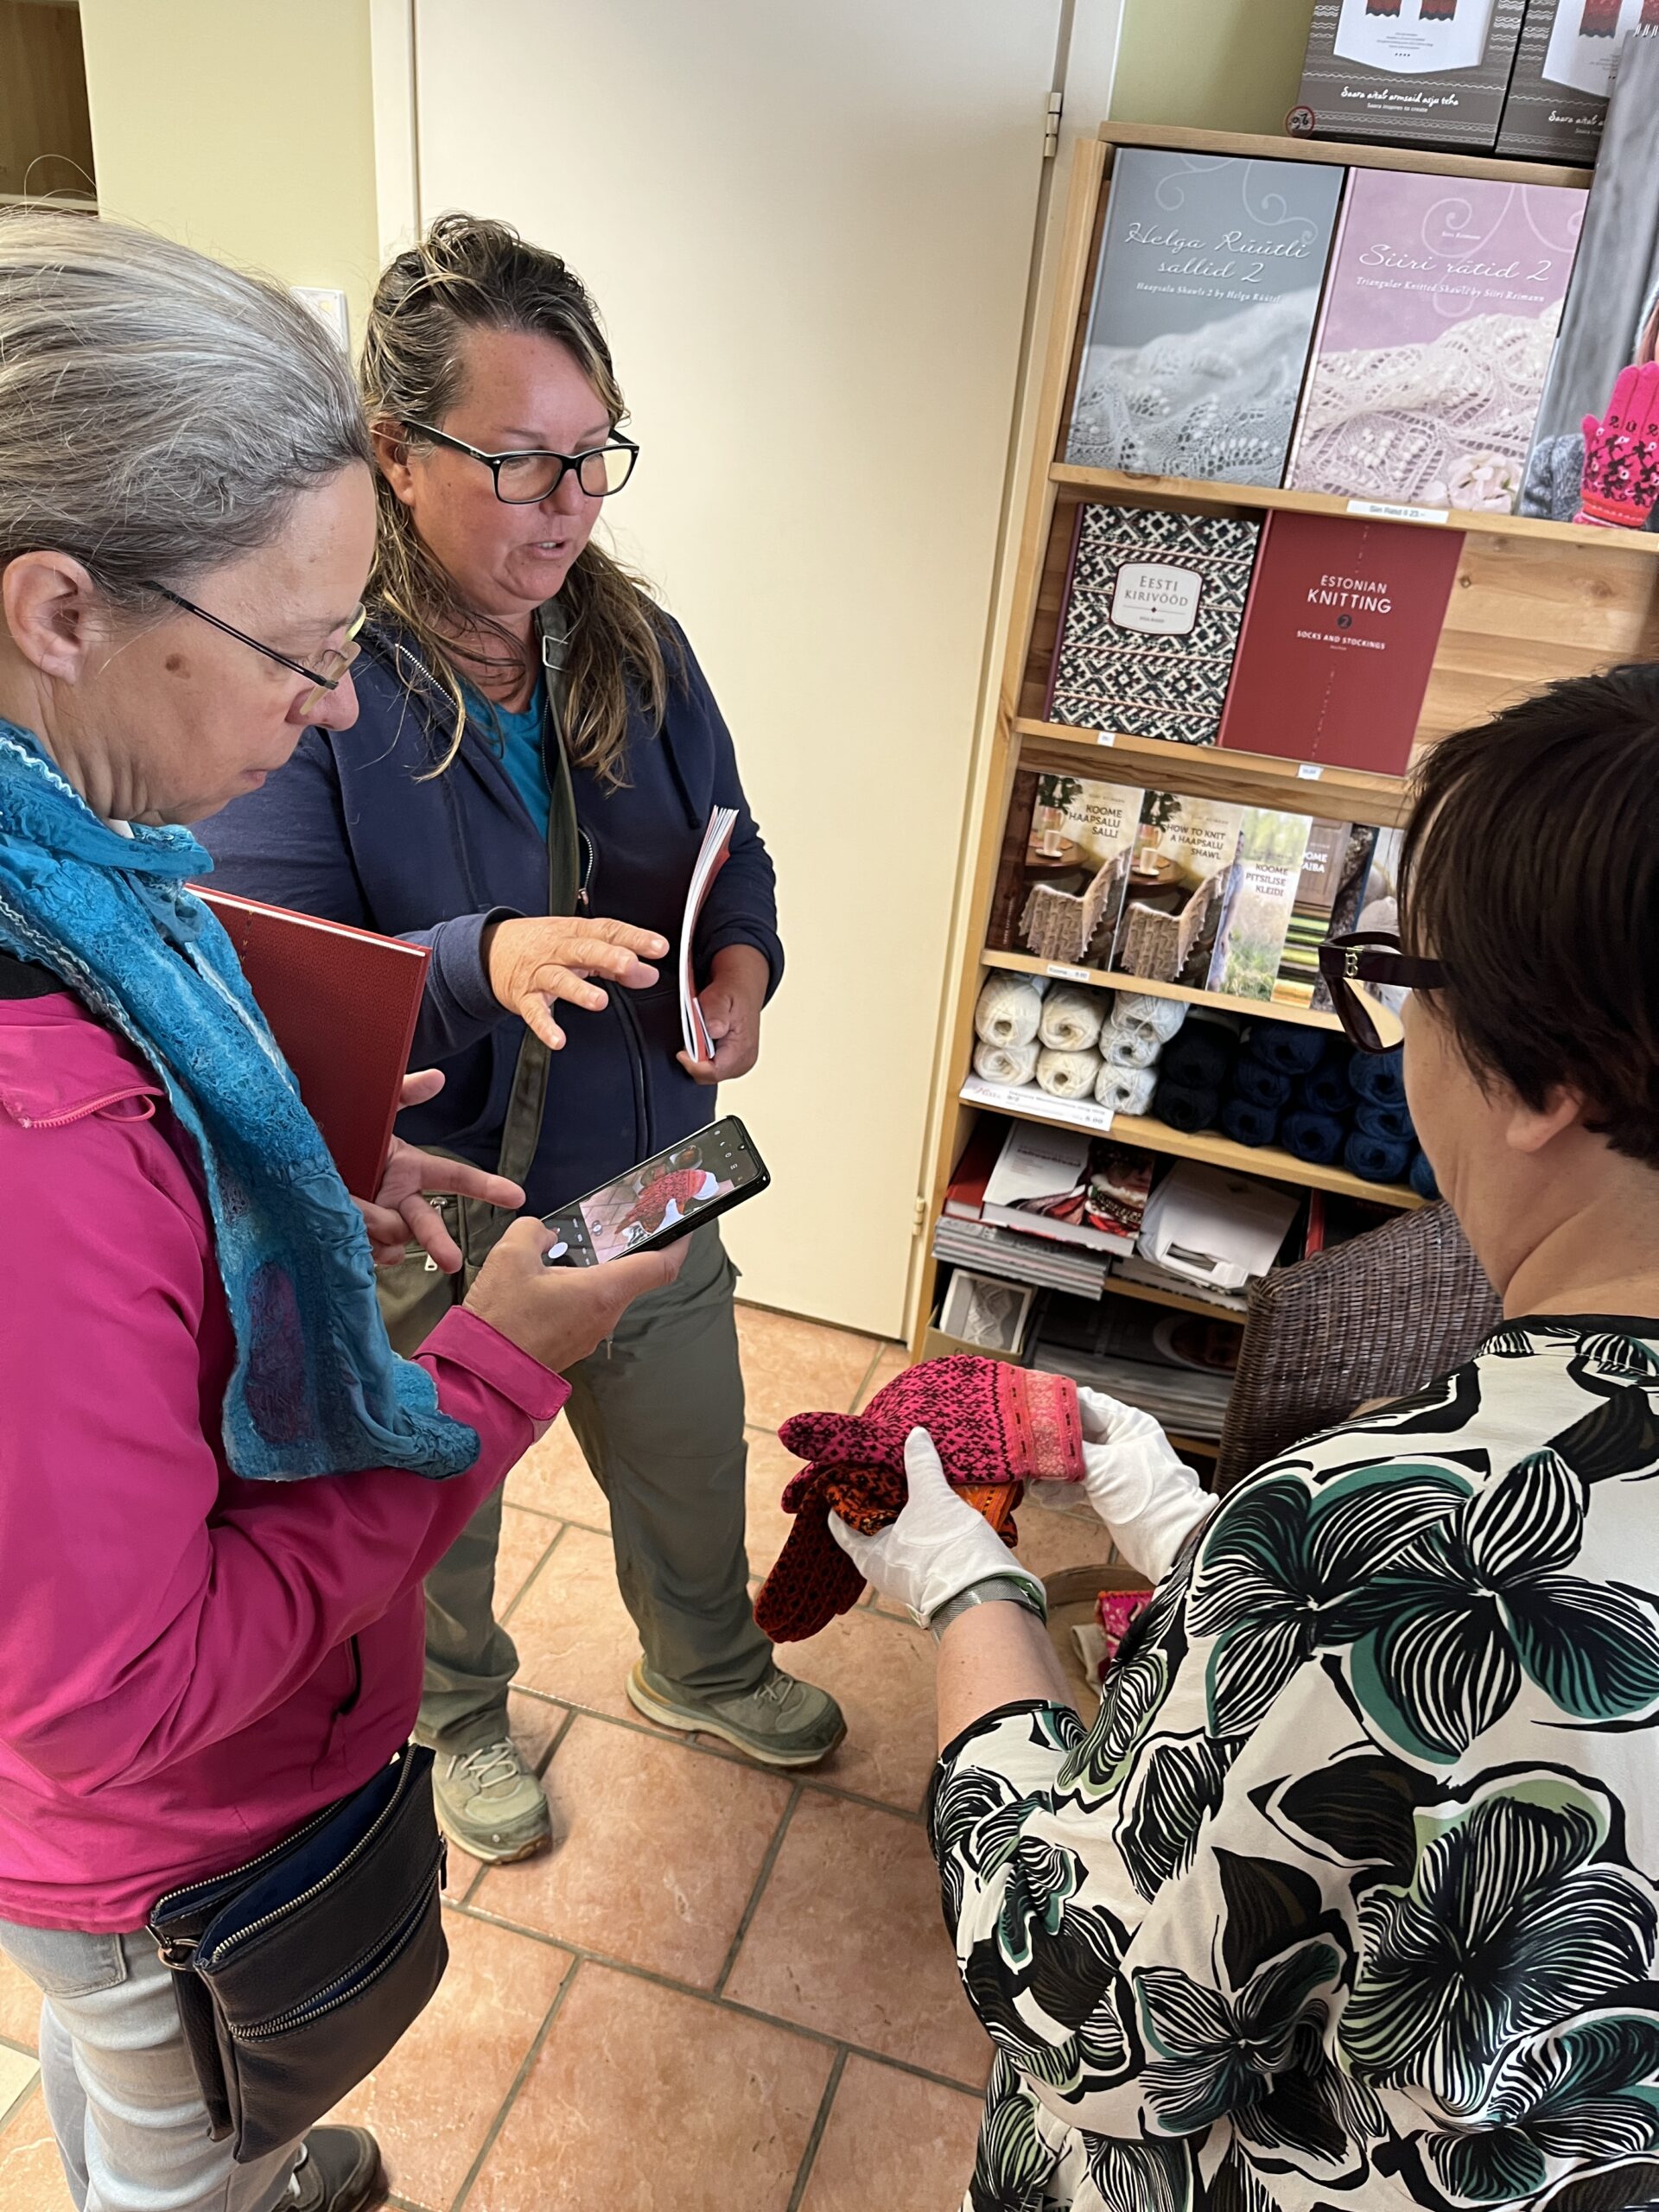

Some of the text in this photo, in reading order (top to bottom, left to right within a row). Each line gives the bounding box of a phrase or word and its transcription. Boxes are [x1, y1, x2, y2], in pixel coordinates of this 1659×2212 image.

[1341, 86, 1365, 98] Saara
[1548, 111, 1573, 123] Saara
[1124, 222, 1311, 259] Helga Rüütli
[1157, 257, 1264, 283] sallid 2
[1358, 244, 1552, 282] Siiri rätid 2
[1177, 286, 1205, 296] Shawls
[1214, 289, 1224, 300] by
[1226, 290, 1250, 302] Helga
[1356, 276, 1402, 289] Triangular
[1403, 281, 1437, 292] Knitted
[1471, 287, 1481, 298] by
[1484, 289, 1504, 299] Siiri
[1505, 291, 1545, 302] Reimann
[1139, 575, 1178, 592] EESTI
[1320, 575, 1387, 594] ESTONIAN
[1306, 588, 1392, 613] KNITTING
[1297, 630, 1321, 640] SOCKS
[1323, 634, 1340, 643] AND
[1342, 637, 1386, 650] STOCKINGS
[1086, 804, 1122, 818] KOOME
[1069, 812, 1121, 828] HAAPSALU
[1092, 826, 1118, 838] SALLI
[1166, 823, 1226, 840] HOW TO KNIT
[1179, 836, 1224, 850] HAAPSALU
[1191, 849, 1221, 860] SHAWL
[1304, 851, 1328, 863] OME
[1255, 863, 1289, 876] KOOME
[1301, 861, 1325, 874] AIBA
[1245, 873, 1287, 887] PITSILISE
[1255, 886, 1284, 897] KLEIDI
